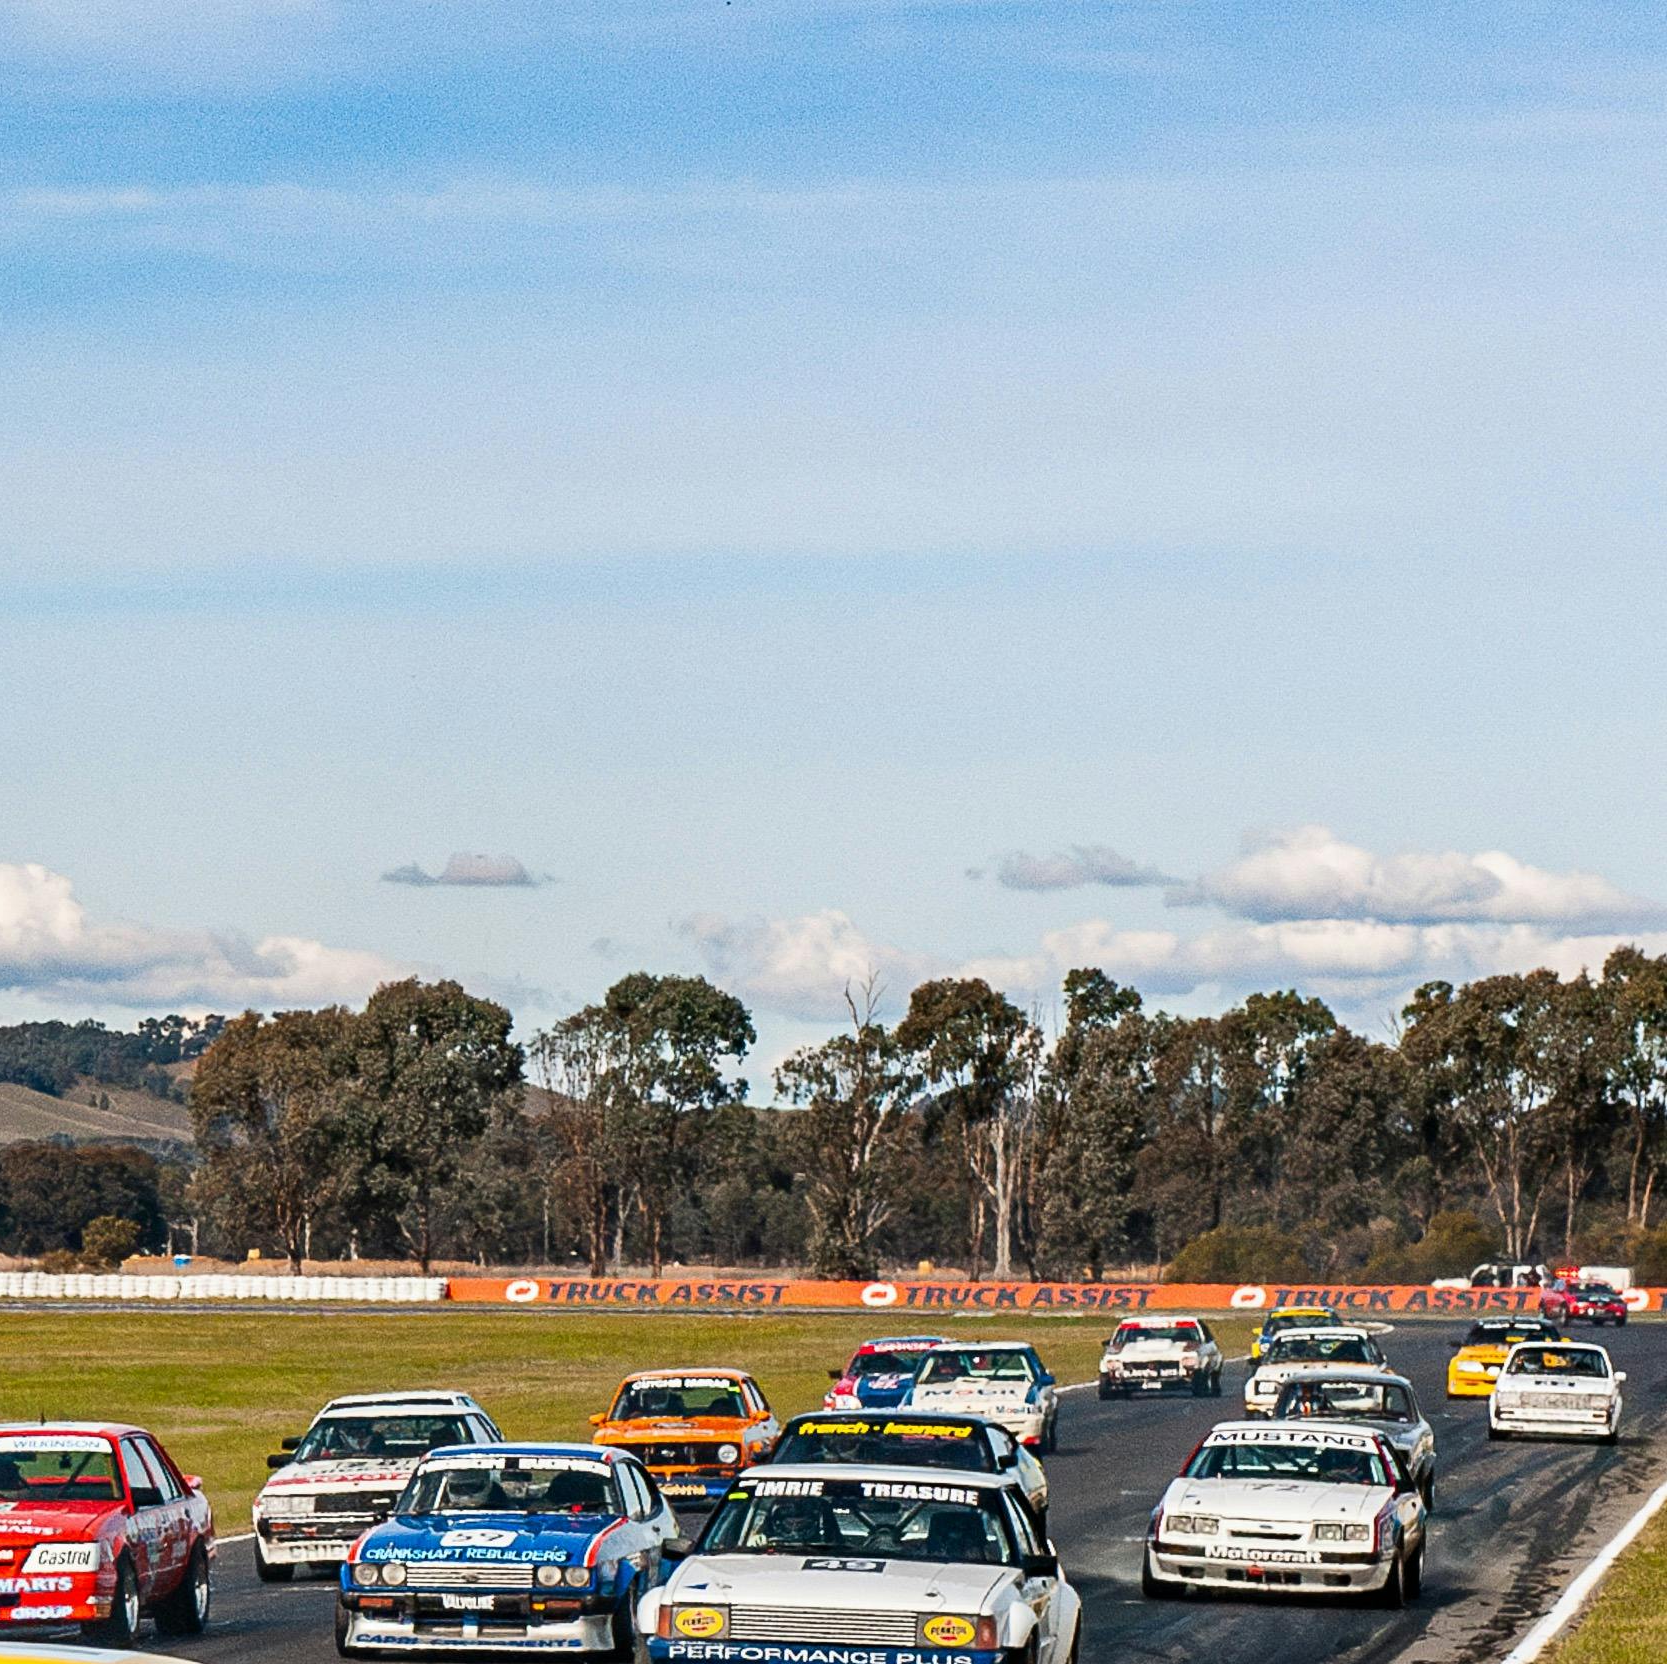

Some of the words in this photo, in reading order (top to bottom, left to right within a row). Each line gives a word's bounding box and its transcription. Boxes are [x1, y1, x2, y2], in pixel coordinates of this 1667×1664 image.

[548, 1283, 660, 1301] TRUCK
[670, 1284, 790, 1303] ASSIST
[905, 1286, 1022, 1305] TRUCK
[1031, 1287, 1156, 1307] ASSIST
[1274, 1289, 1394, 1308] TRUCK
[1405, 1290, 1534, 1310] ASSIST
[13, 1439, 100, 1449] WILKINSON
[1213, 1432, 1367, 1447] MUSTANG
[754, 1480, 825, 1497] IMRIE
[860, 1482, 979, 1506] TREASURE
[38, 1550, 91, 1566] Castrol
[365, 1547, 462, 1562] CRANKSHAFT
[466, 1547, 568, 1562] REBUILDERS
[1204, 1545, 1322, 1564] Motorcraft
